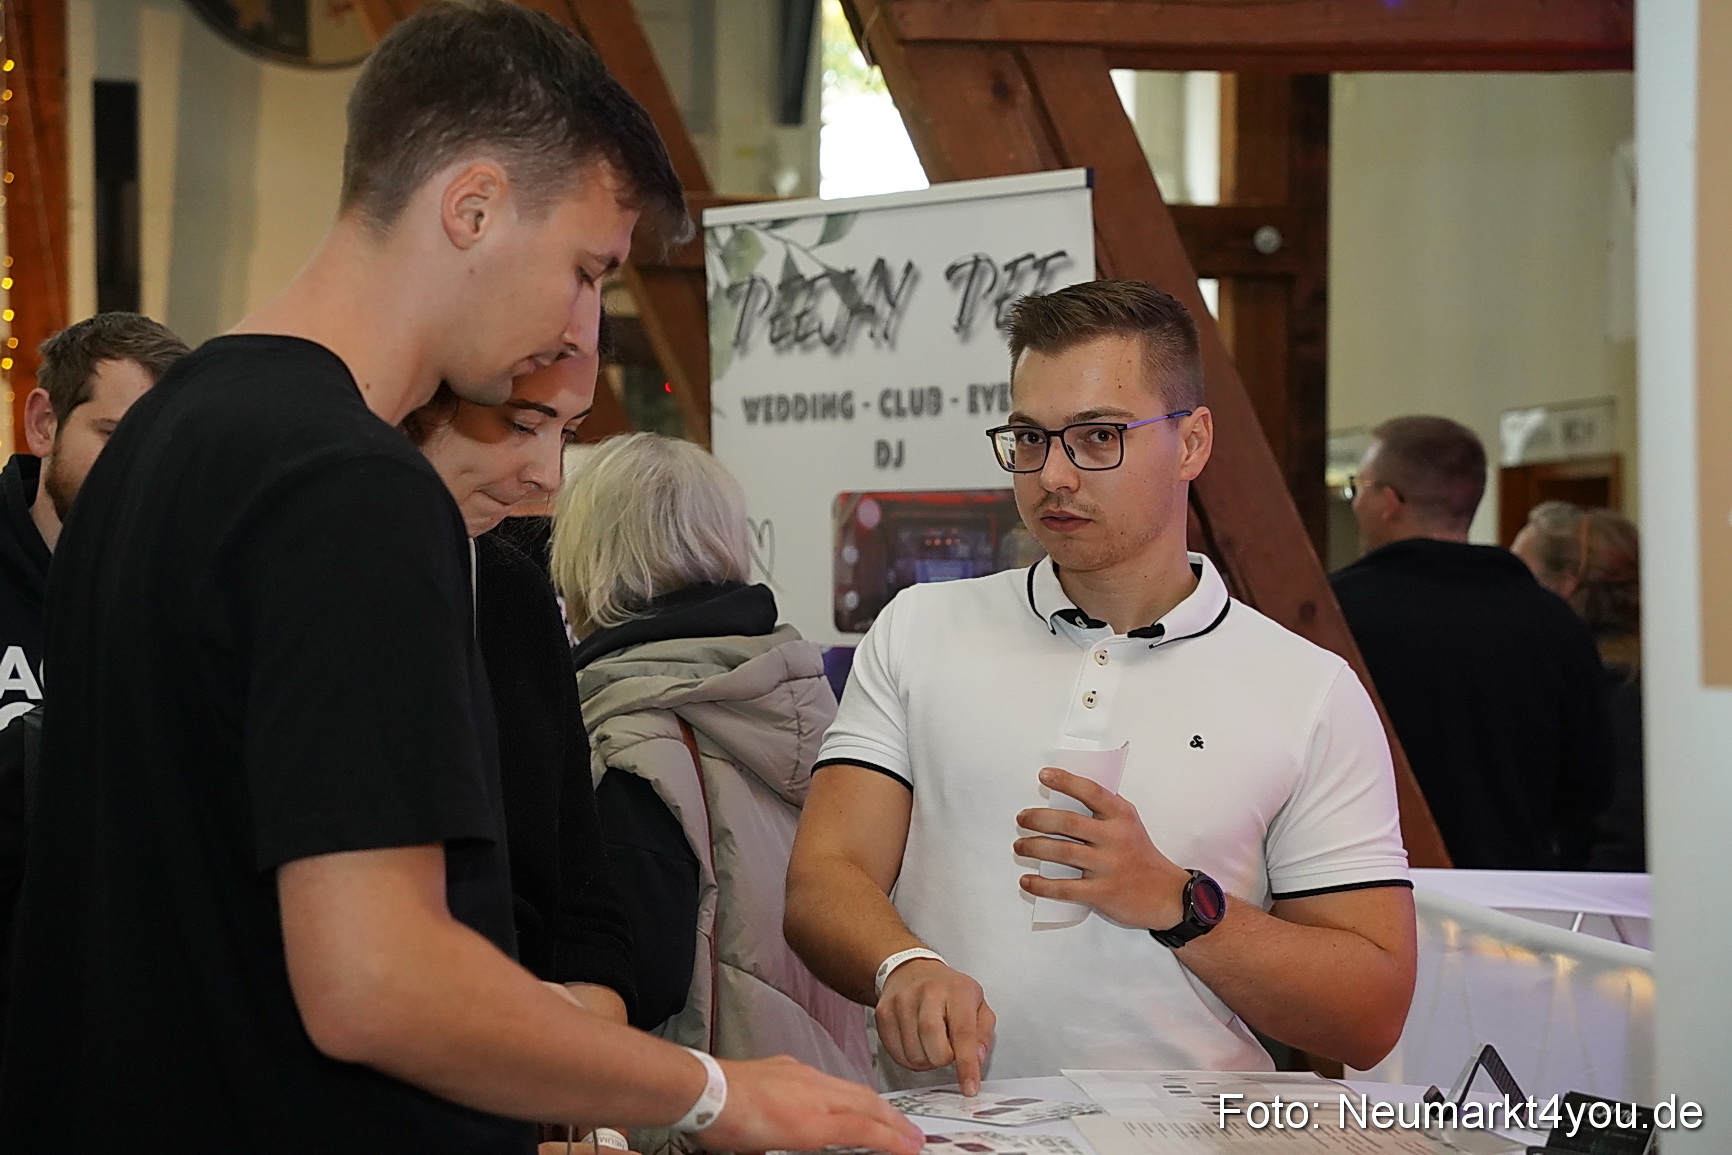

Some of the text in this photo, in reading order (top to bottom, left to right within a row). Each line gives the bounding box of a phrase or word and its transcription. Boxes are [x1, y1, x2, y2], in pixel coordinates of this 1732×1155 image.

[742, 390, 856, 425] WEDDING
[878, 385, 944, 418] CLUB
[874, 438, 905, 470] DJ
